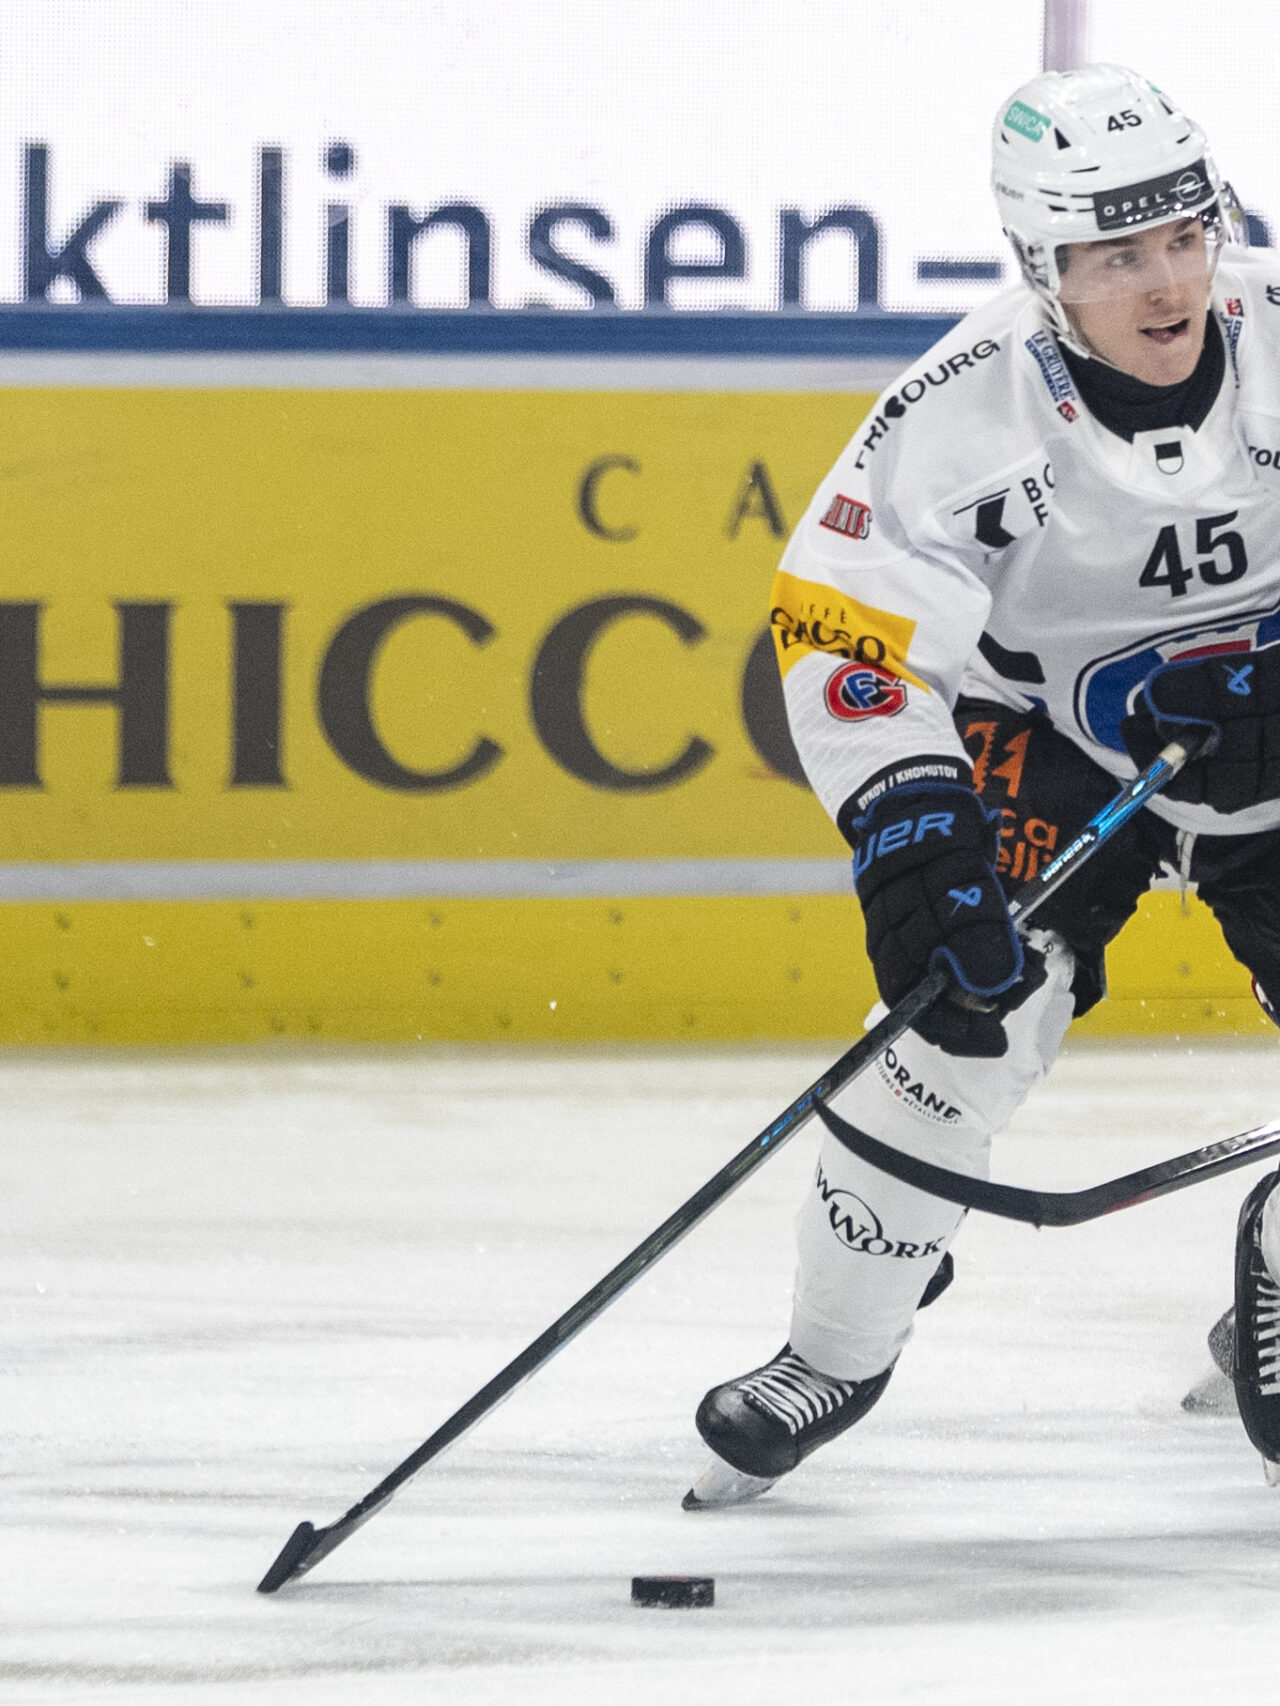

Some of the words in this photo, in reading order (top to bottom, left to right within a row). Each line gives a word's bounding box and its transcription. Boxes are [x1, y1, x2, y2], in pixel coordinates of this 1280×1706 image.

[1106, 108, 1143, 133] 45
[1102, 192, 1166, 217] OPEL
[1138, 509, 1249, 598] 45
[0, 592, 812, 792] HICC
[895, 763, 958, 785] KHOMUTOV
